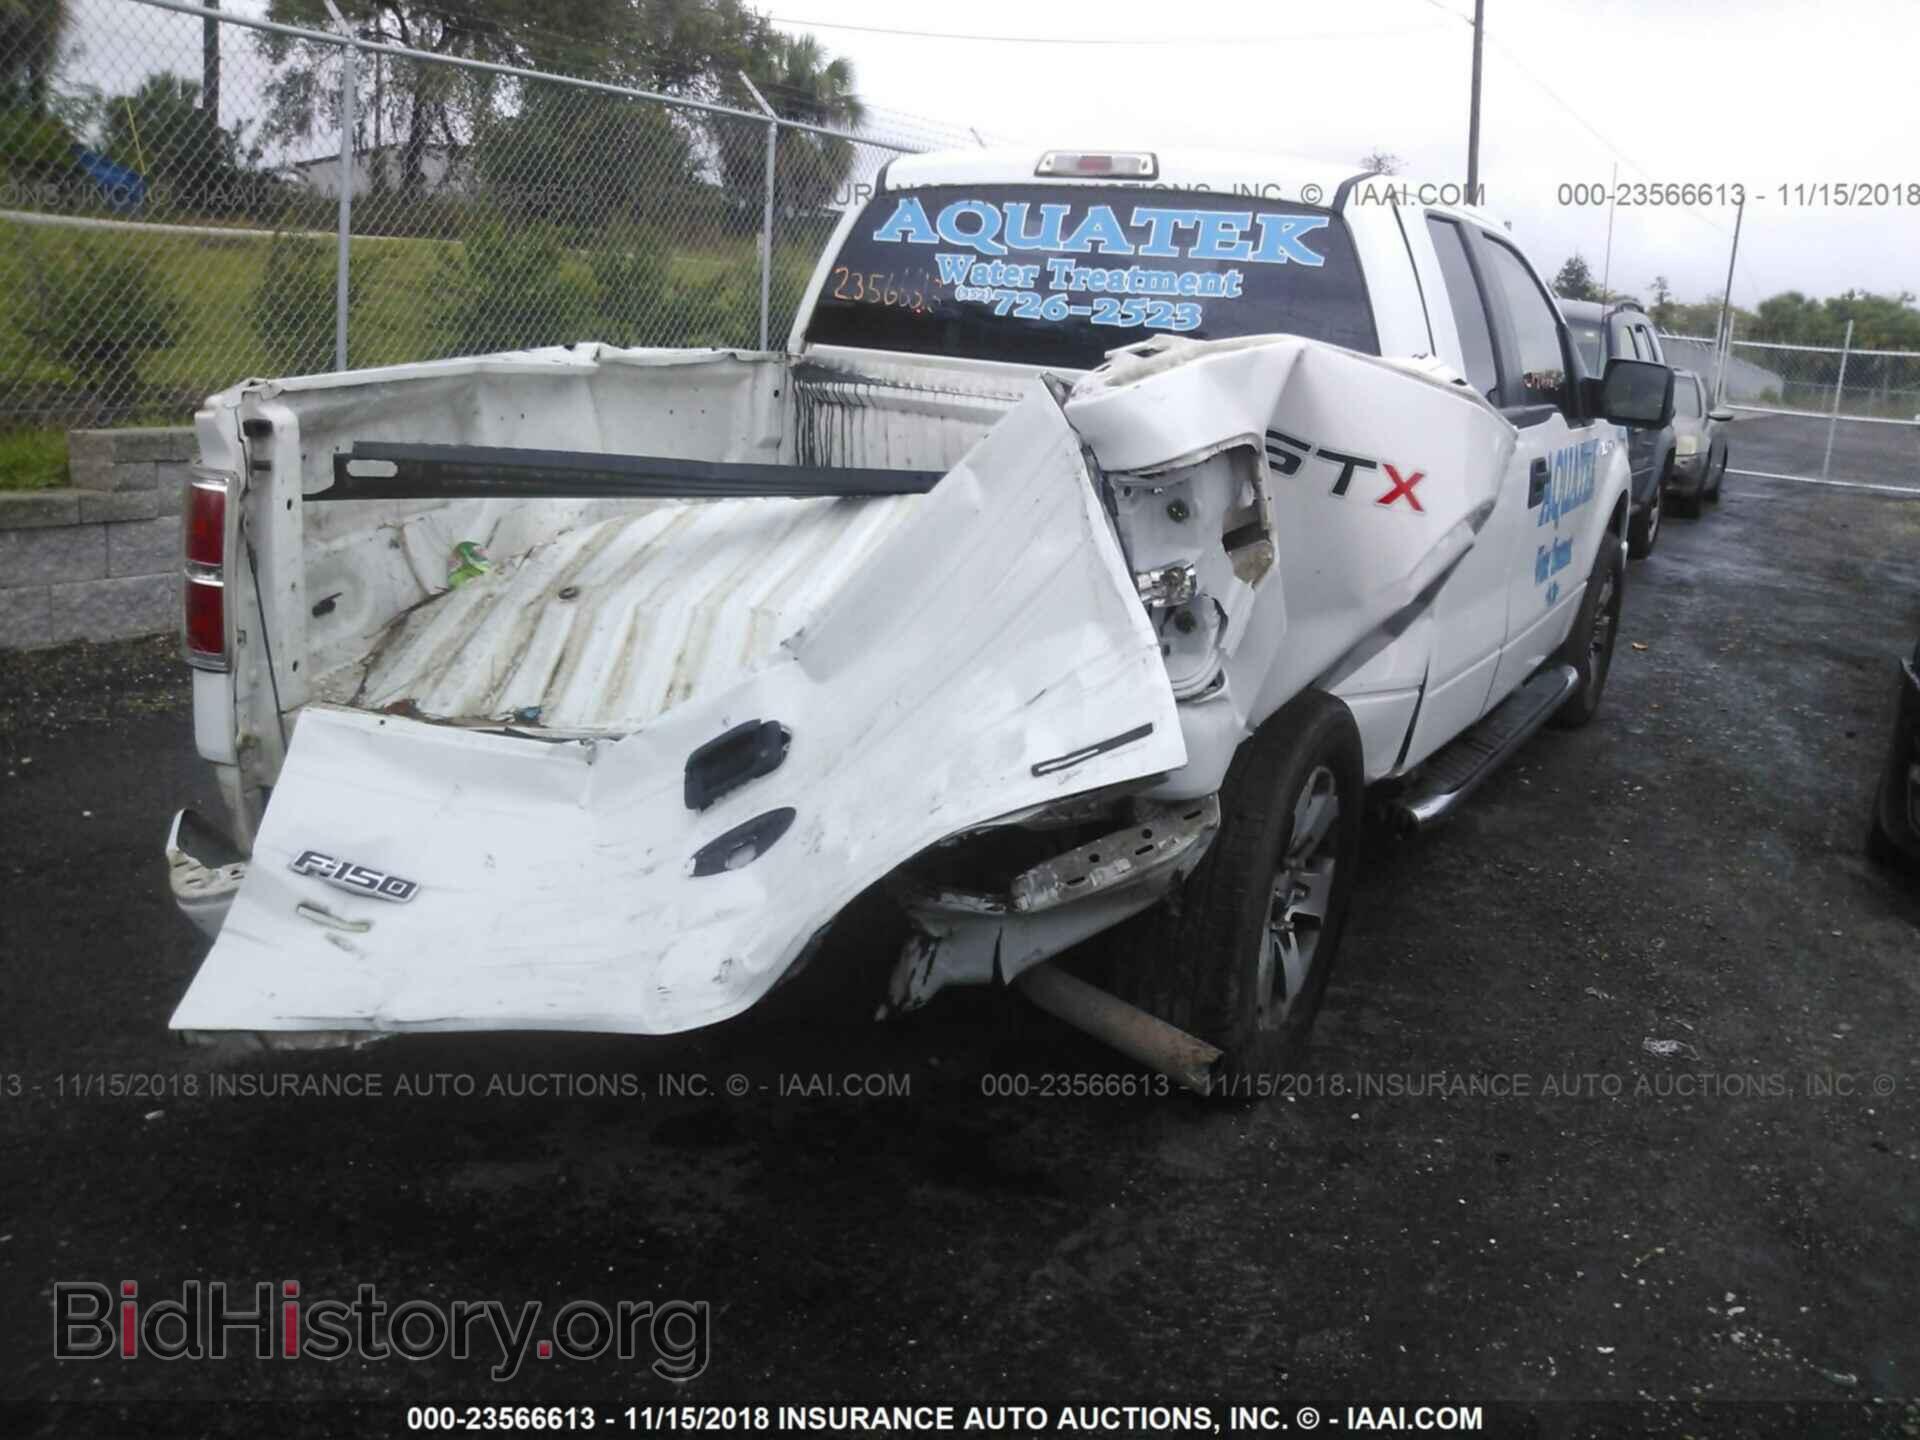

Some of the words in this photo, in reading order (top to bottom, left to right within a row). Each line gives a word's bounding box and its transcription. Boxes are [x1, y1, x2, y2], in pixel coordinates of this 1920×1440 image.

[873, 197, 1330, 268] AQUATEK
[935, 253, 1039, 288] Water
[1047, 257, 1243, 298] Treatment
[1266, 428, 1425, 513] STX
[292, 849, 419, 901] F-150
